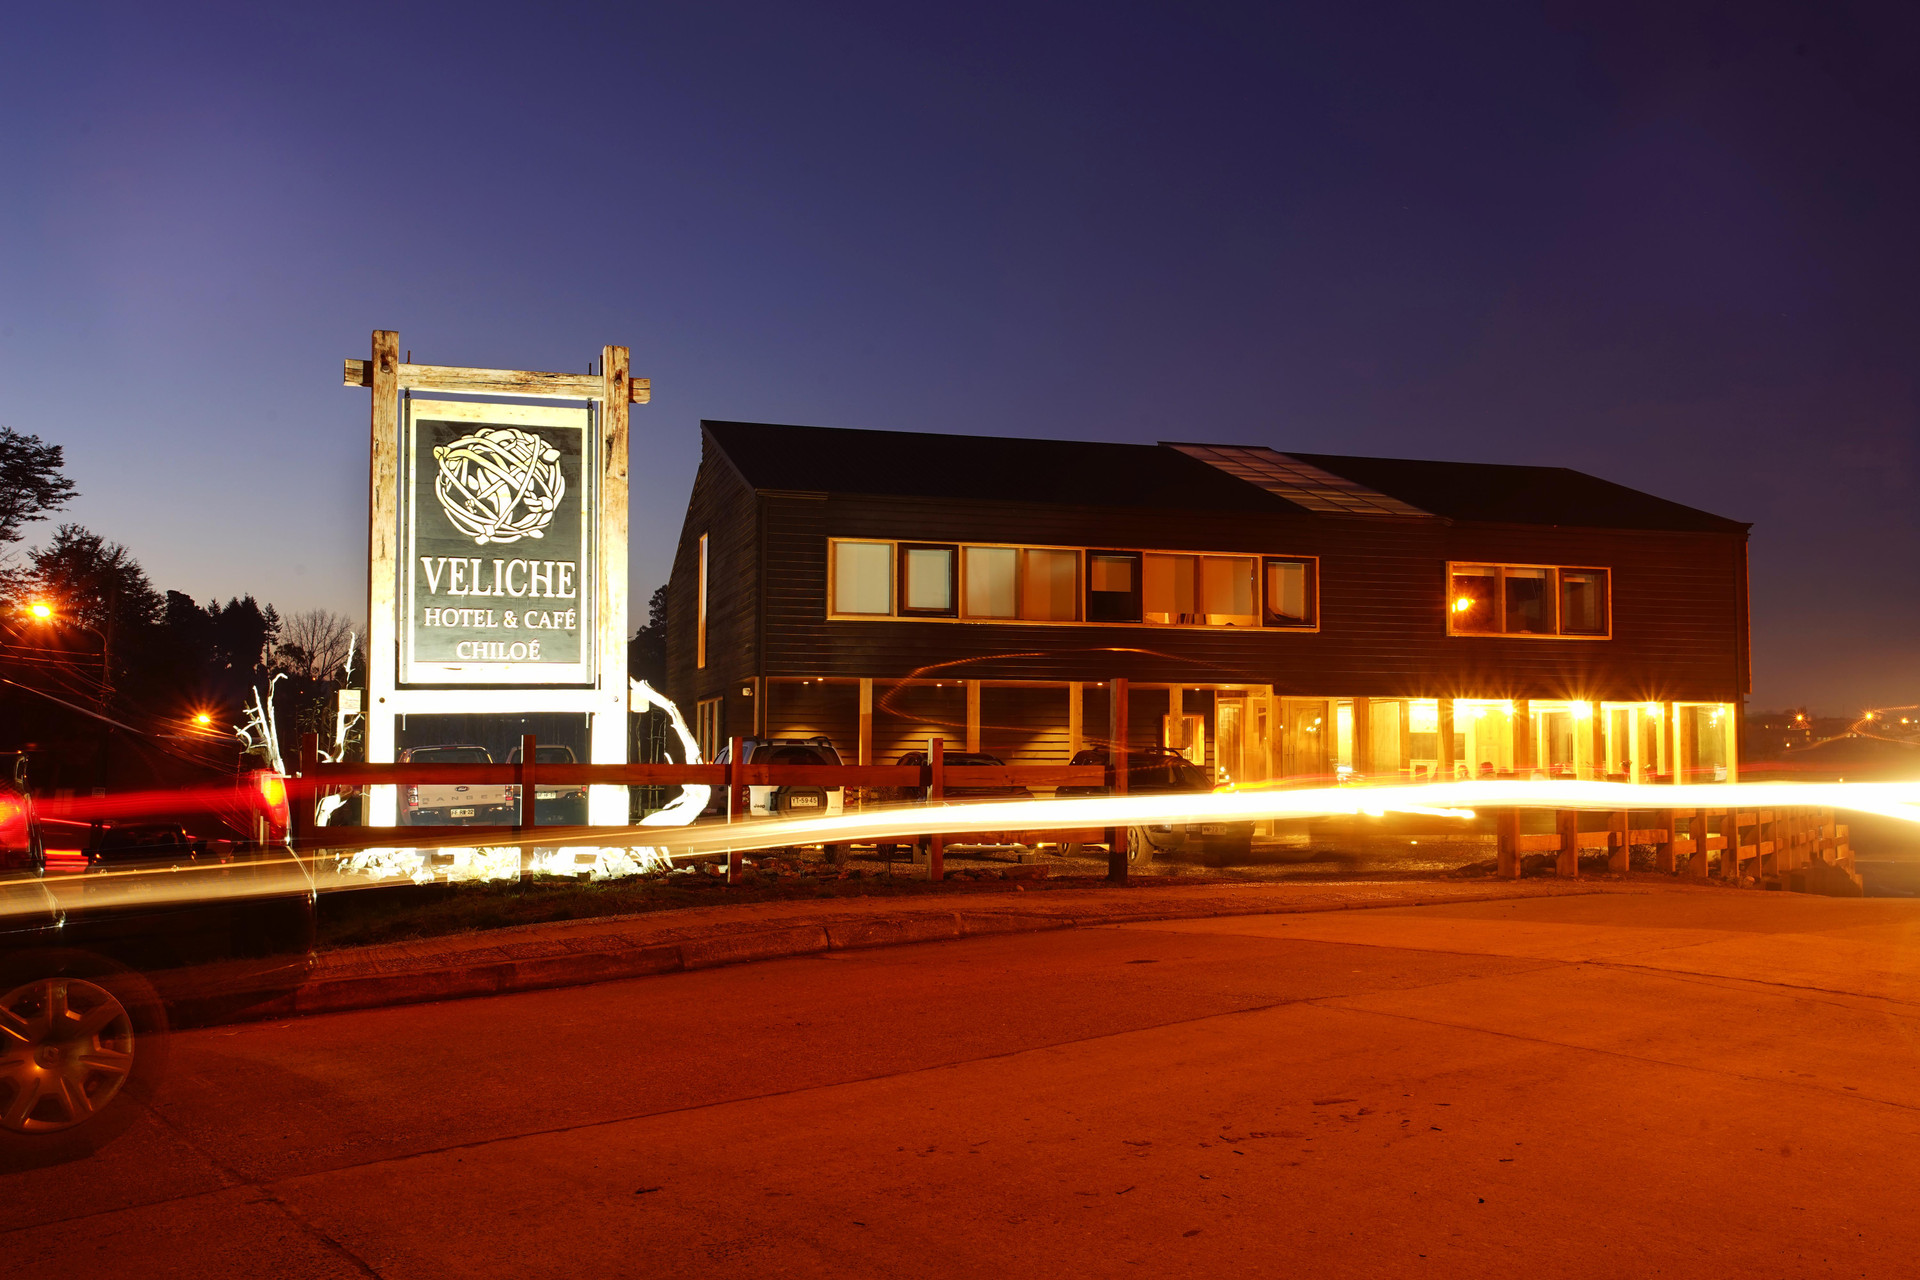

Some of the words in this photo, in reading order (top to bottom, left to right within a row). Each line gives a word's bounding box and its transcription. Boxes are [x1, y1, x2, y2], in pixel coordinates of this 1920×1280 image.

[420, 556, 576, 598] VELICHE
[424, 607, 498, 628] HOTEL
[503, 610, 518, 628] &
[524, 608, 576, 630] CAFÉ
[456, 638, 541, 660] CHILOÉ
